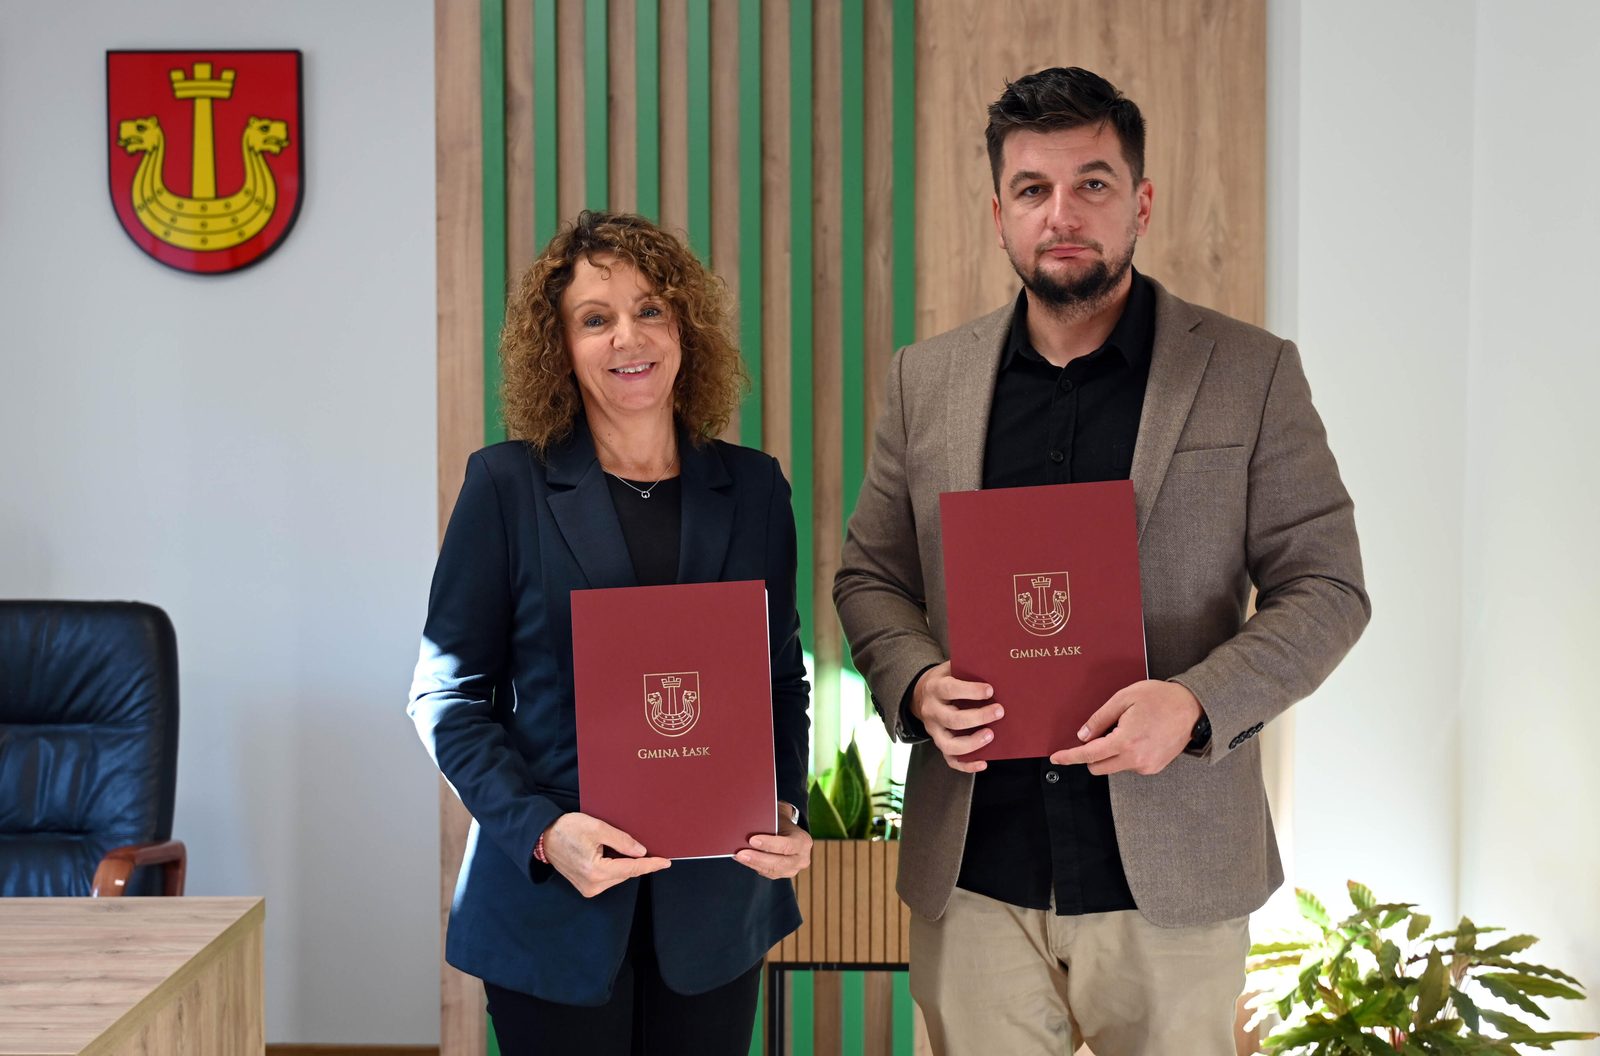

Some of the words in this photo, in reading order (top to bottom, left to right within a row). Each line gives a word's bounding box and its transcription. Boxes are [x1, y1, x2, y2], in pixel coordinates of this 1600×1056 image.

[1009, 648, 1051, 659] GMINA
[1053, 646, 1082, 656] ŁASK
[637, 748, 680, 760] GMINA
[682, 746, 711, 757] ŁASK
